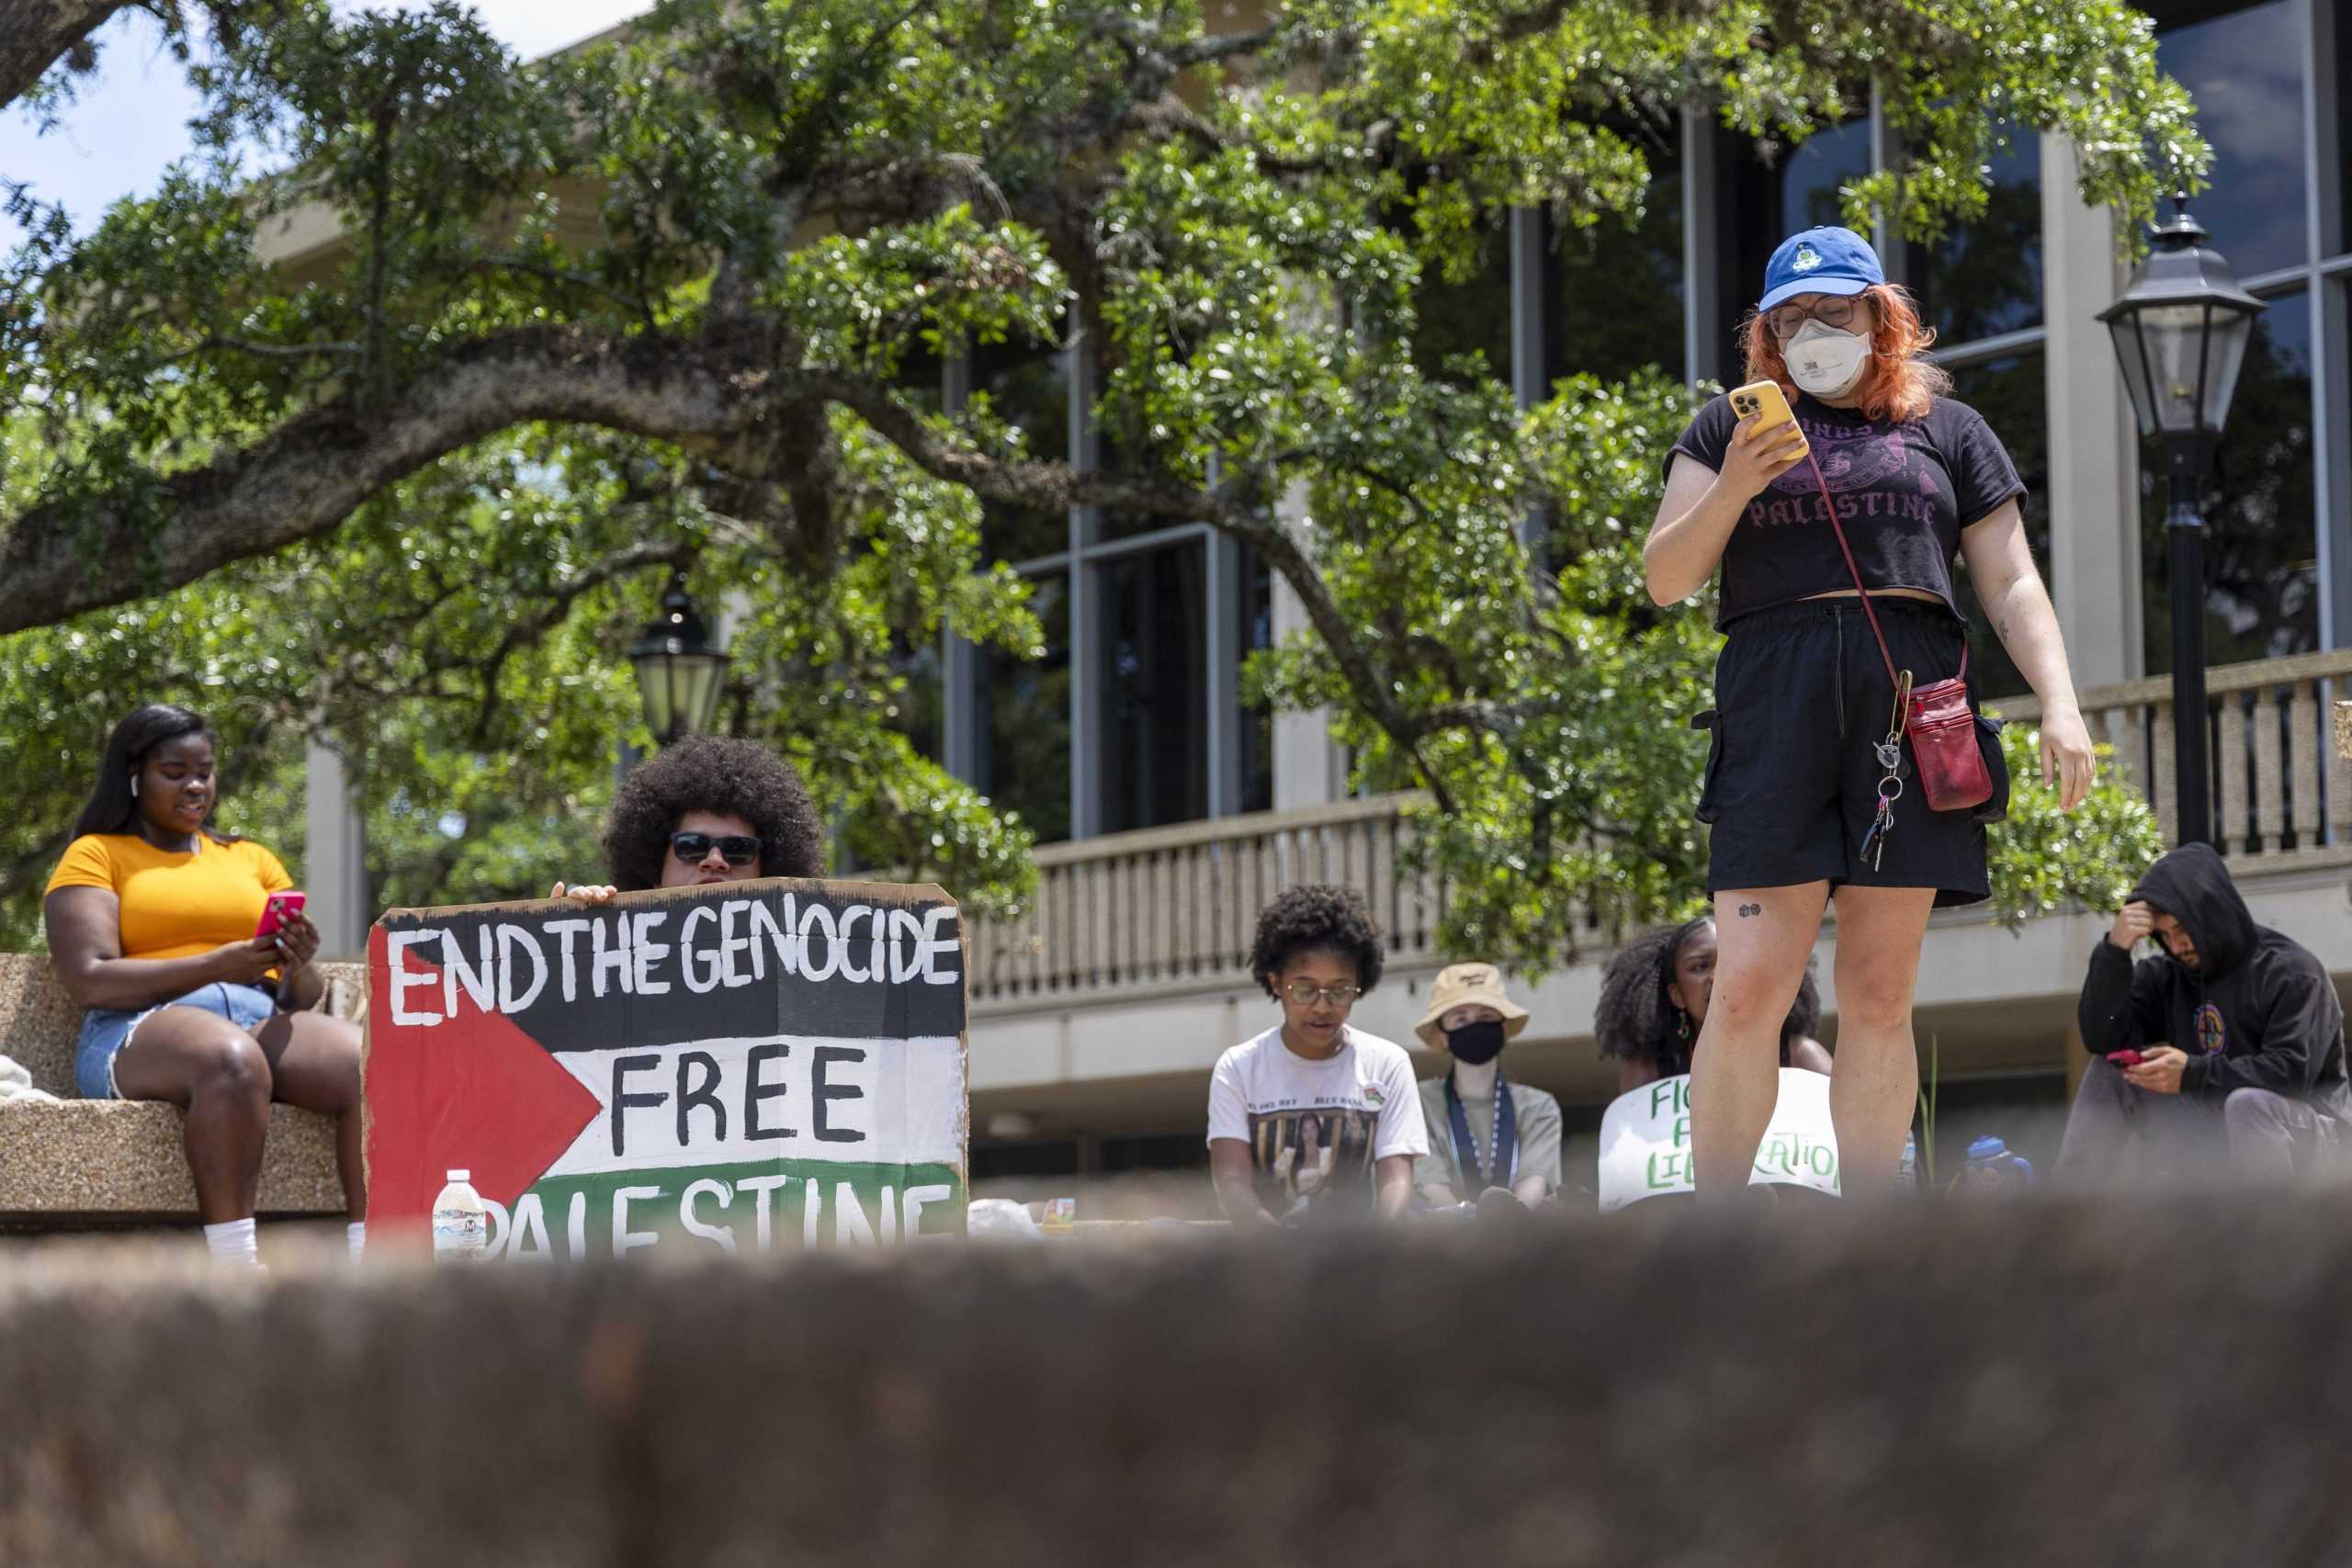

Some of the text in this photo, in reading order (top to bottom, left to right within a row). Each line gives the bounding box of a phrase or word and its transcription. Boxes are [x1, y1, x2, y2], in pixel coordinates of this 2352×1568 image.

[1748, 492, 1938, 528] PALESTINE
[389, 892, 960, 1026] END THE GENOCIDE
[612, 1044, 866, 1156] FREE
[484, 1174, 952, 1262] PALESTINE
